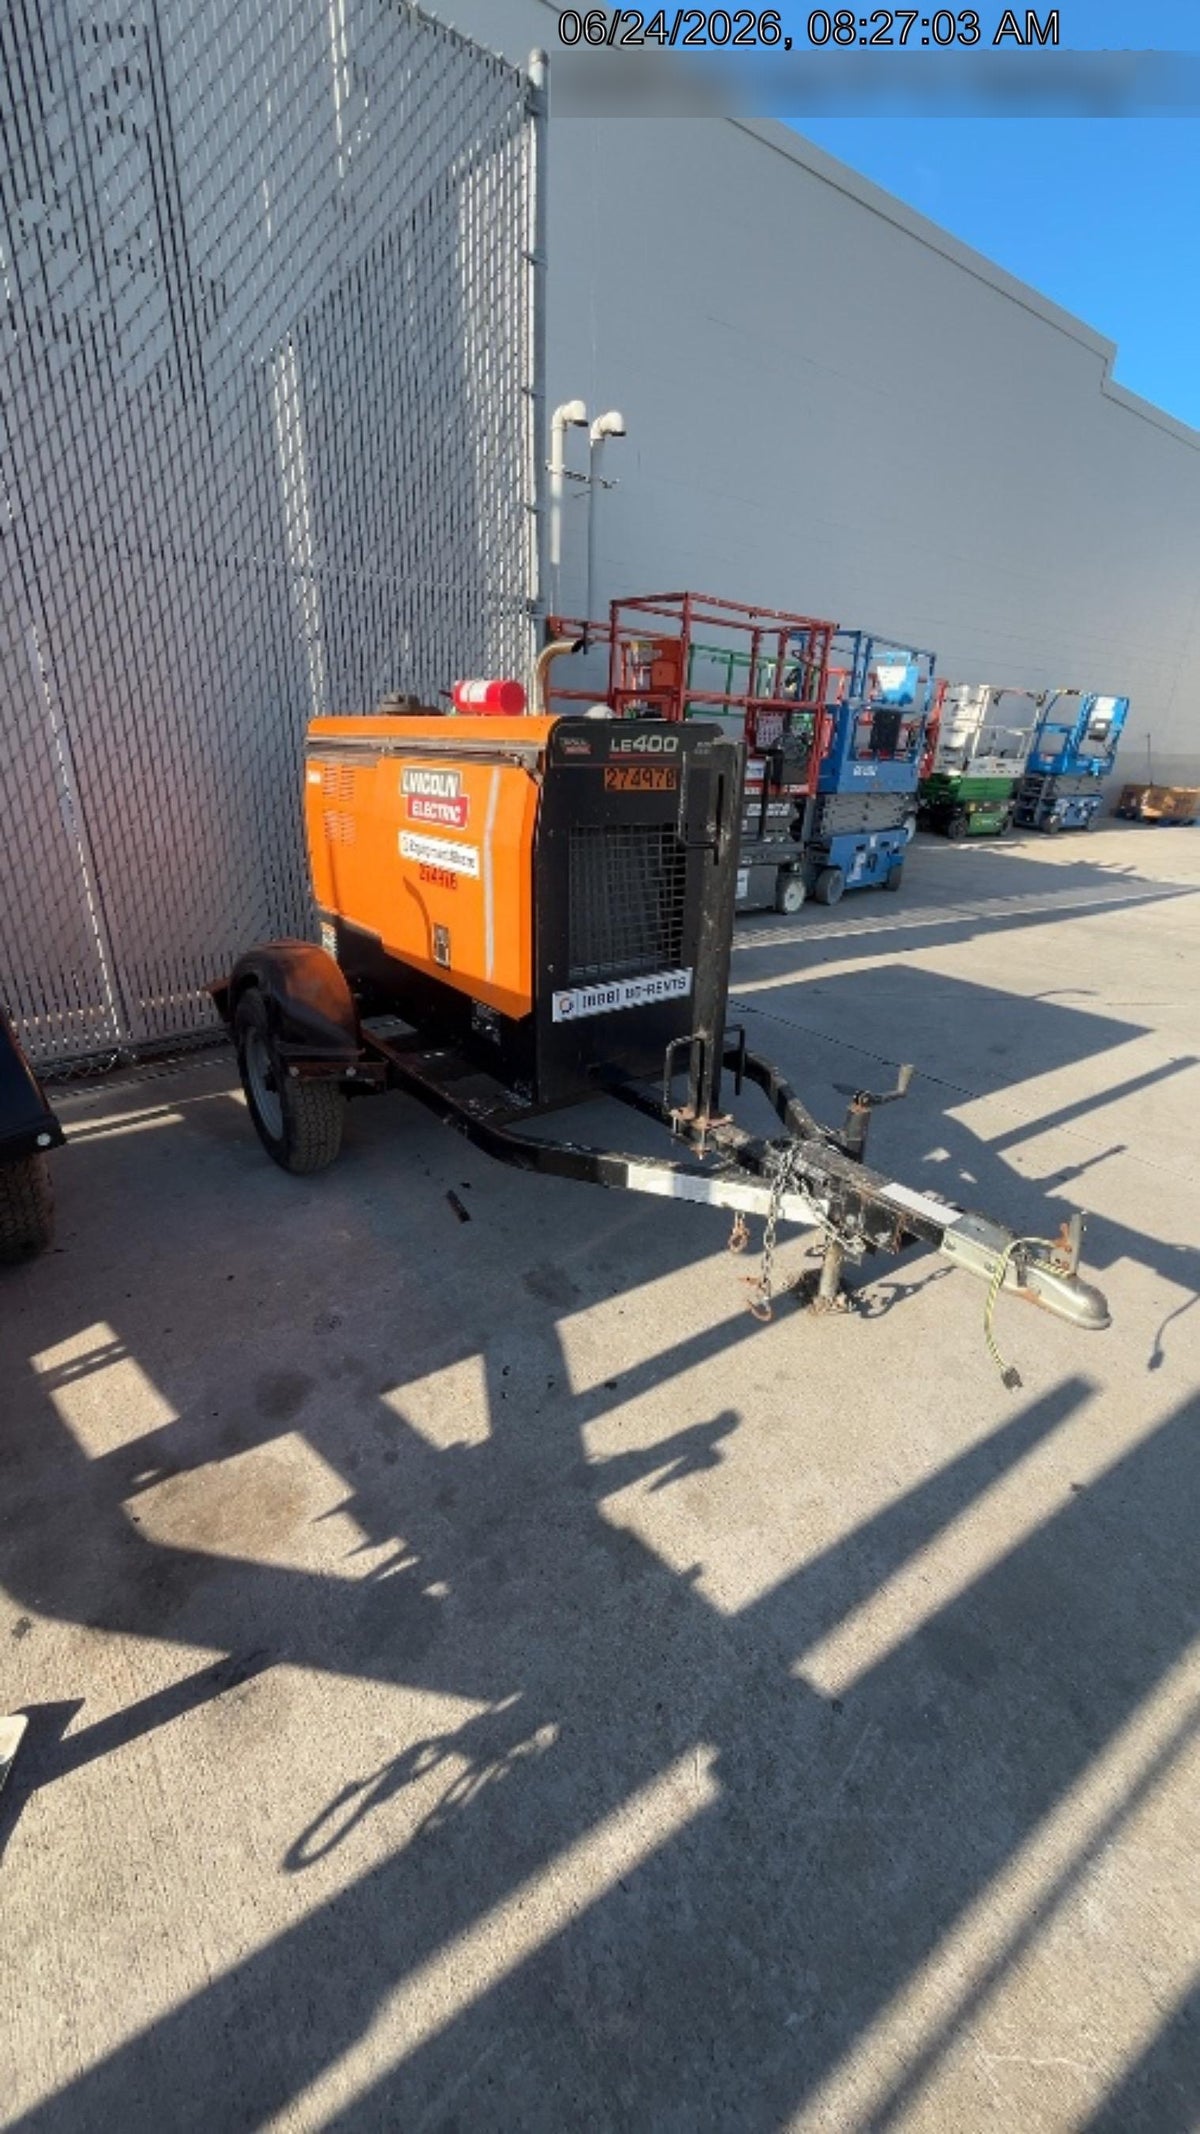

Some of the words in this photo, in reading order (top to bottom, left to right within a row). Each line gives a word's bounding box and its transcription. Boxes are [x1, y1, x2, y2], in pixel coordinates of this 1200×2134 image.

[610, 735, 679, 753] LE400
[402, 769, 458, 799] LINCOLN
[411, 799, 461, 824] ELECTRIC
